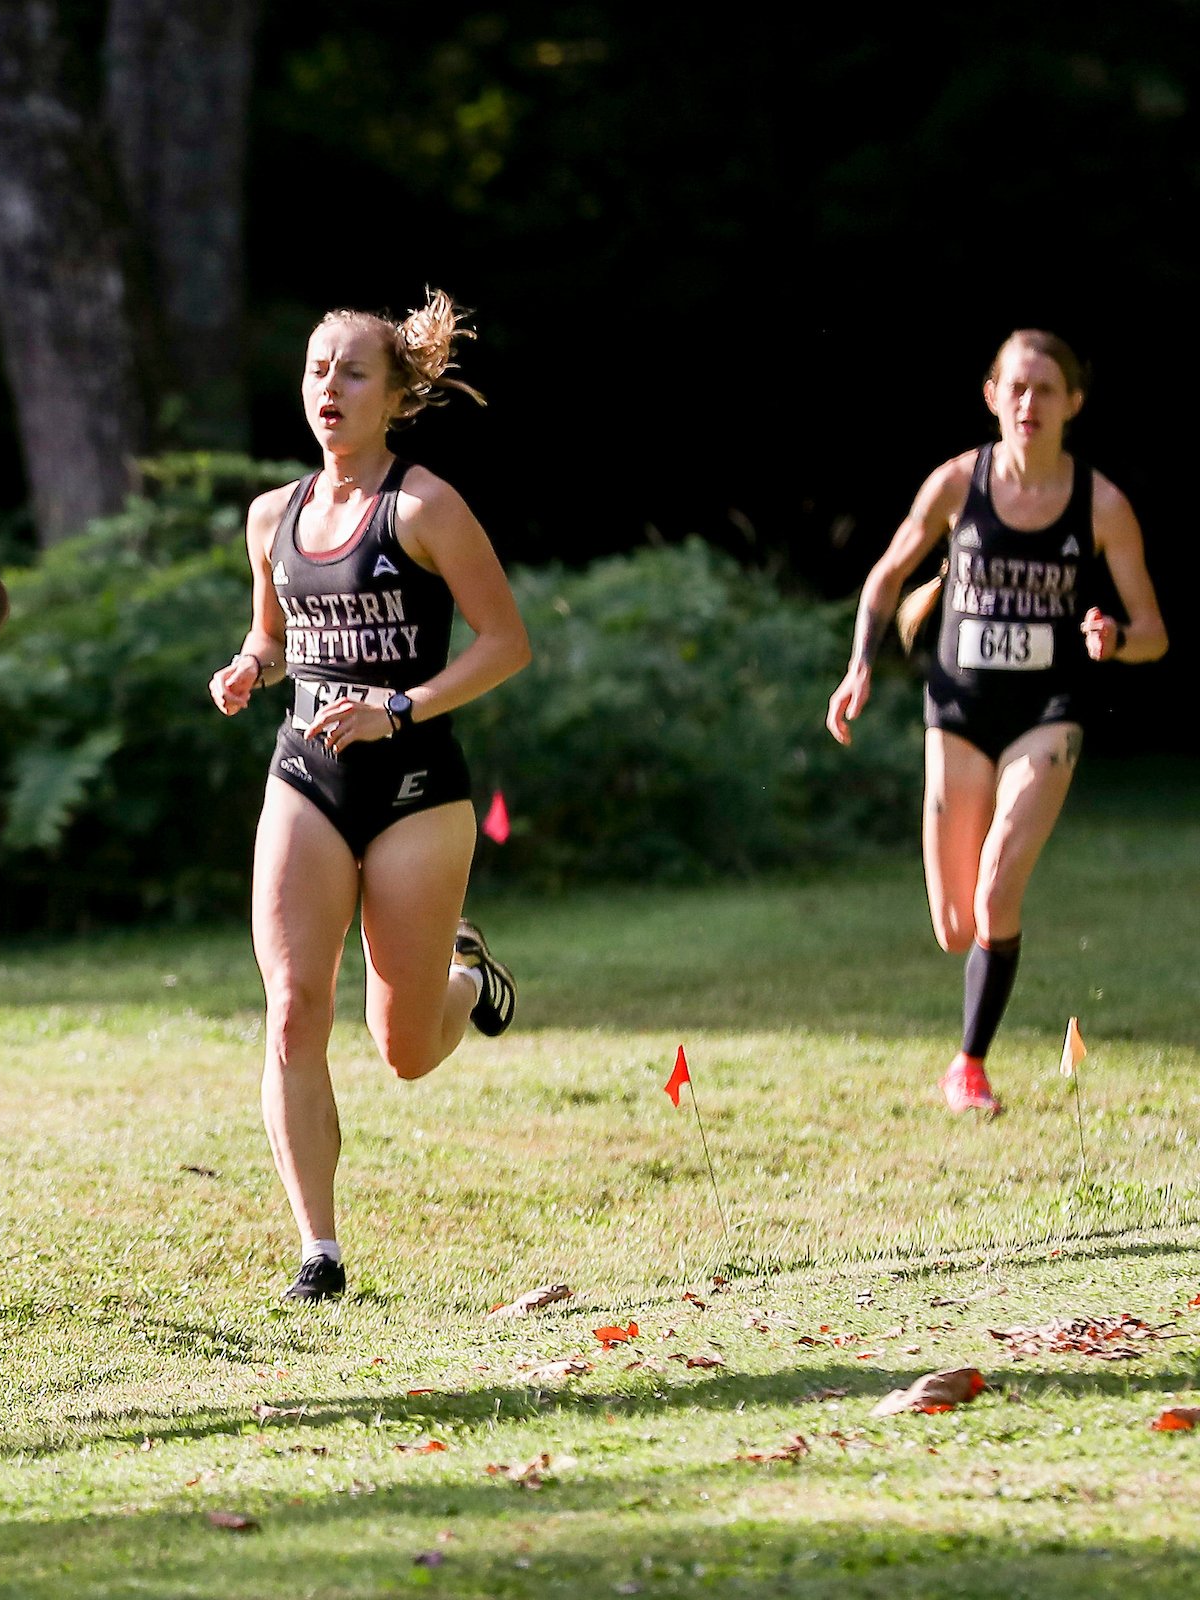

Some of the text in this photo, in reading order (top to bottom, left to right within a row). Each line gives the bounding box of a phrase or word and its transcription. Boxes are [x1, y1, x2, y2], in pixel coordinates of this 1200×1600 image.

[957, 551, 1077, 594] EASTERN
[279, 589, 405, 628] EASTERN
[981, 624, 1030, 661] 643
